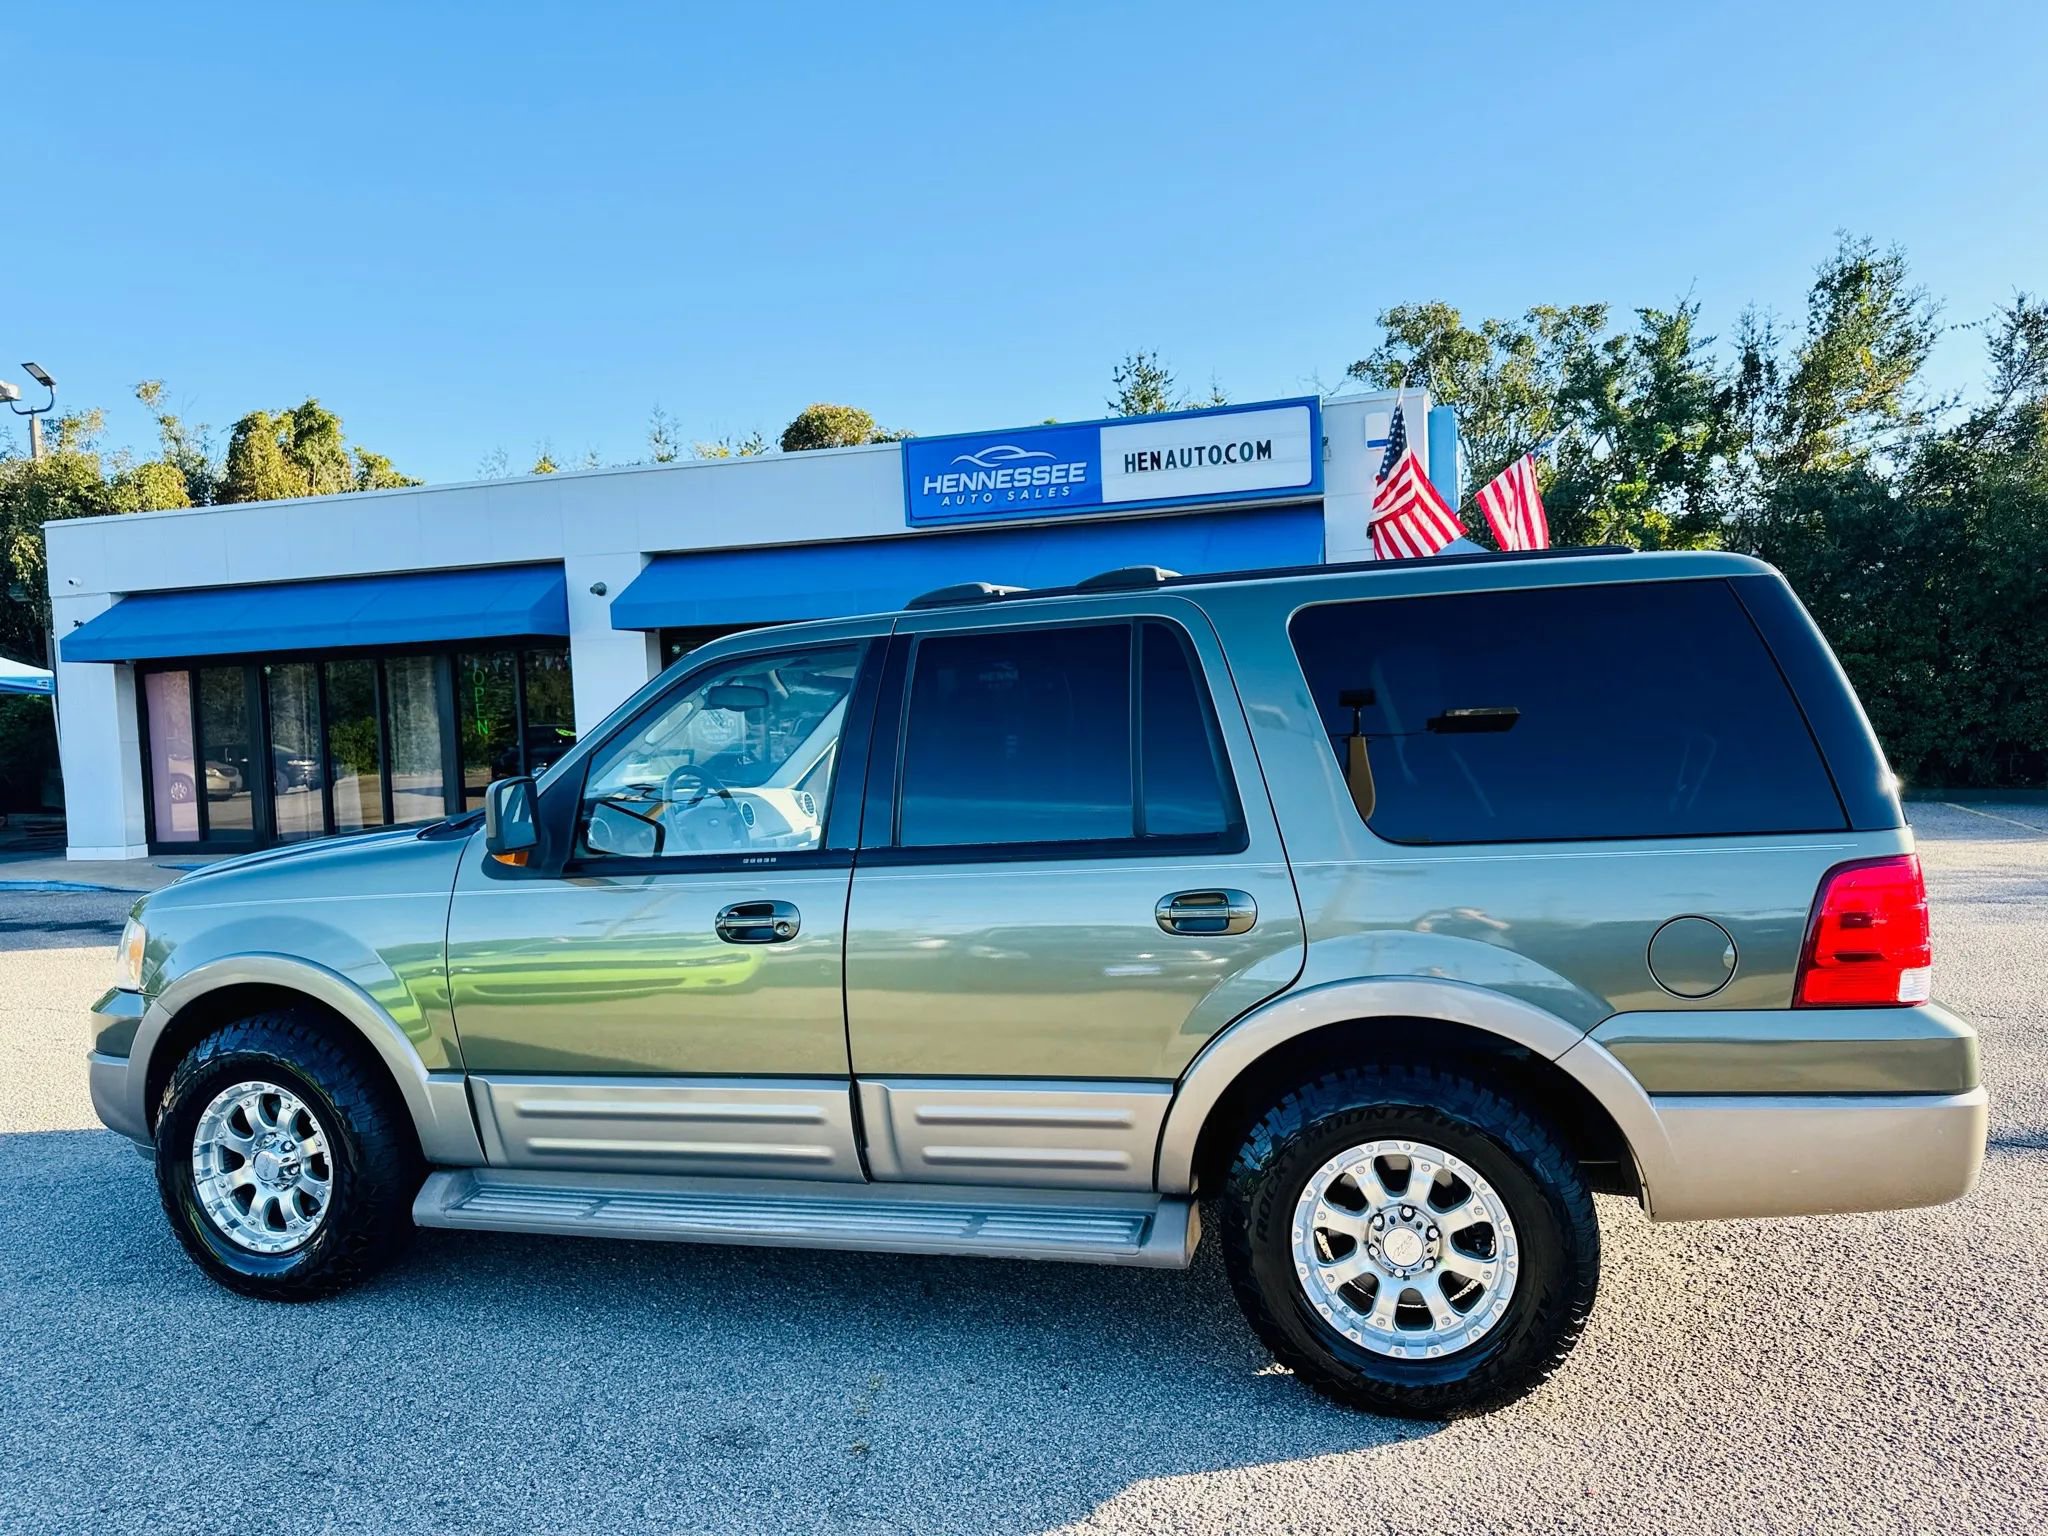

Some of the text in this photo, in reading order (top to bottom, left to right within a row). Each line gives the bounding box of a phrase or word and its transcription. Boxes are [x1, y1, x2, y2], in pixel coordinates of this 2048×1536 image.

[1124, 440, 1271, 473] HENAUTO.COM
[923, 462, 1087, 495] HENNESSEE
[941, 486, 1071, 506] AUTO SALES
[473, 669, 489, 735] OPEN
